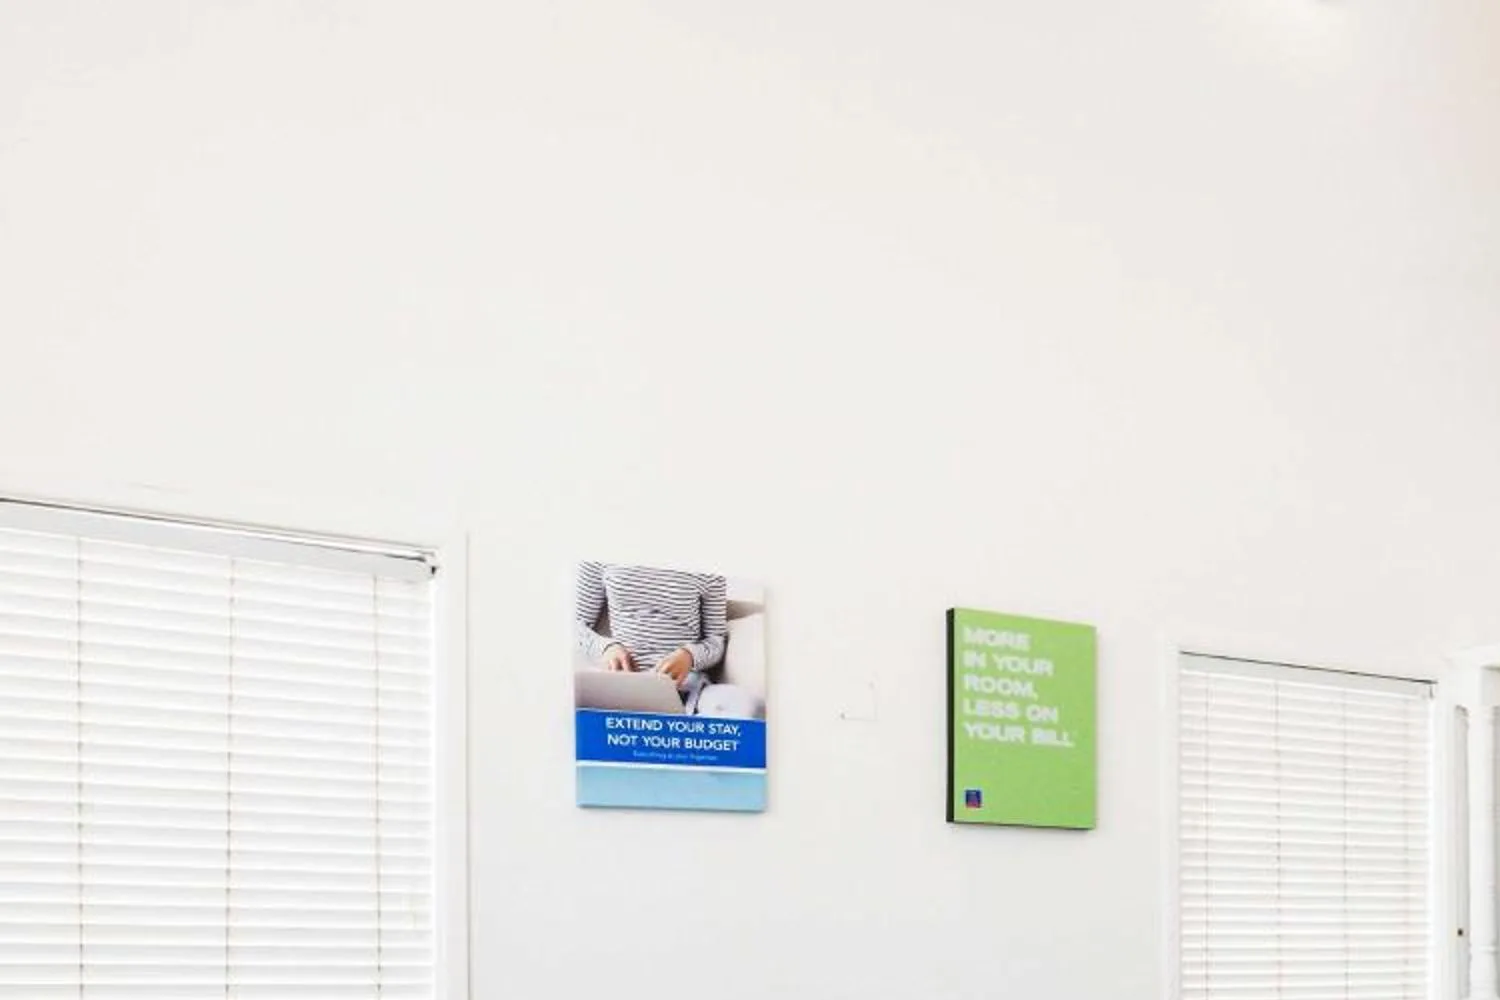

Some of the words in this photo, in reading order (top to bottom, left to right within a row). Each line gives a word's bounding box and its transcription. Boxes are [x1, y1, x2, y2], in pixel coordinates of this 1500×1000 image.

[963, 627, 1030, 651] MORE
[963, 650, 987, 668] IN
[993, 653, 1055, 676] YOUR
[962, 673, 1039, 700] ROOM,
[963, 699, 1020, 720] LESS
[1026, 704, 1058, 724] ON
[605, 717, 662, 731] EXTEND
[667, 721, 705, 733] YOUR
[708, 723, 741, 737] STAY,
[963, 722, 1025, 743] YOUR
[607, 733, 639, 746] NOT
[641, 735, 681, 749] YOUR
[684, 738, 739, 751] BUDGET
